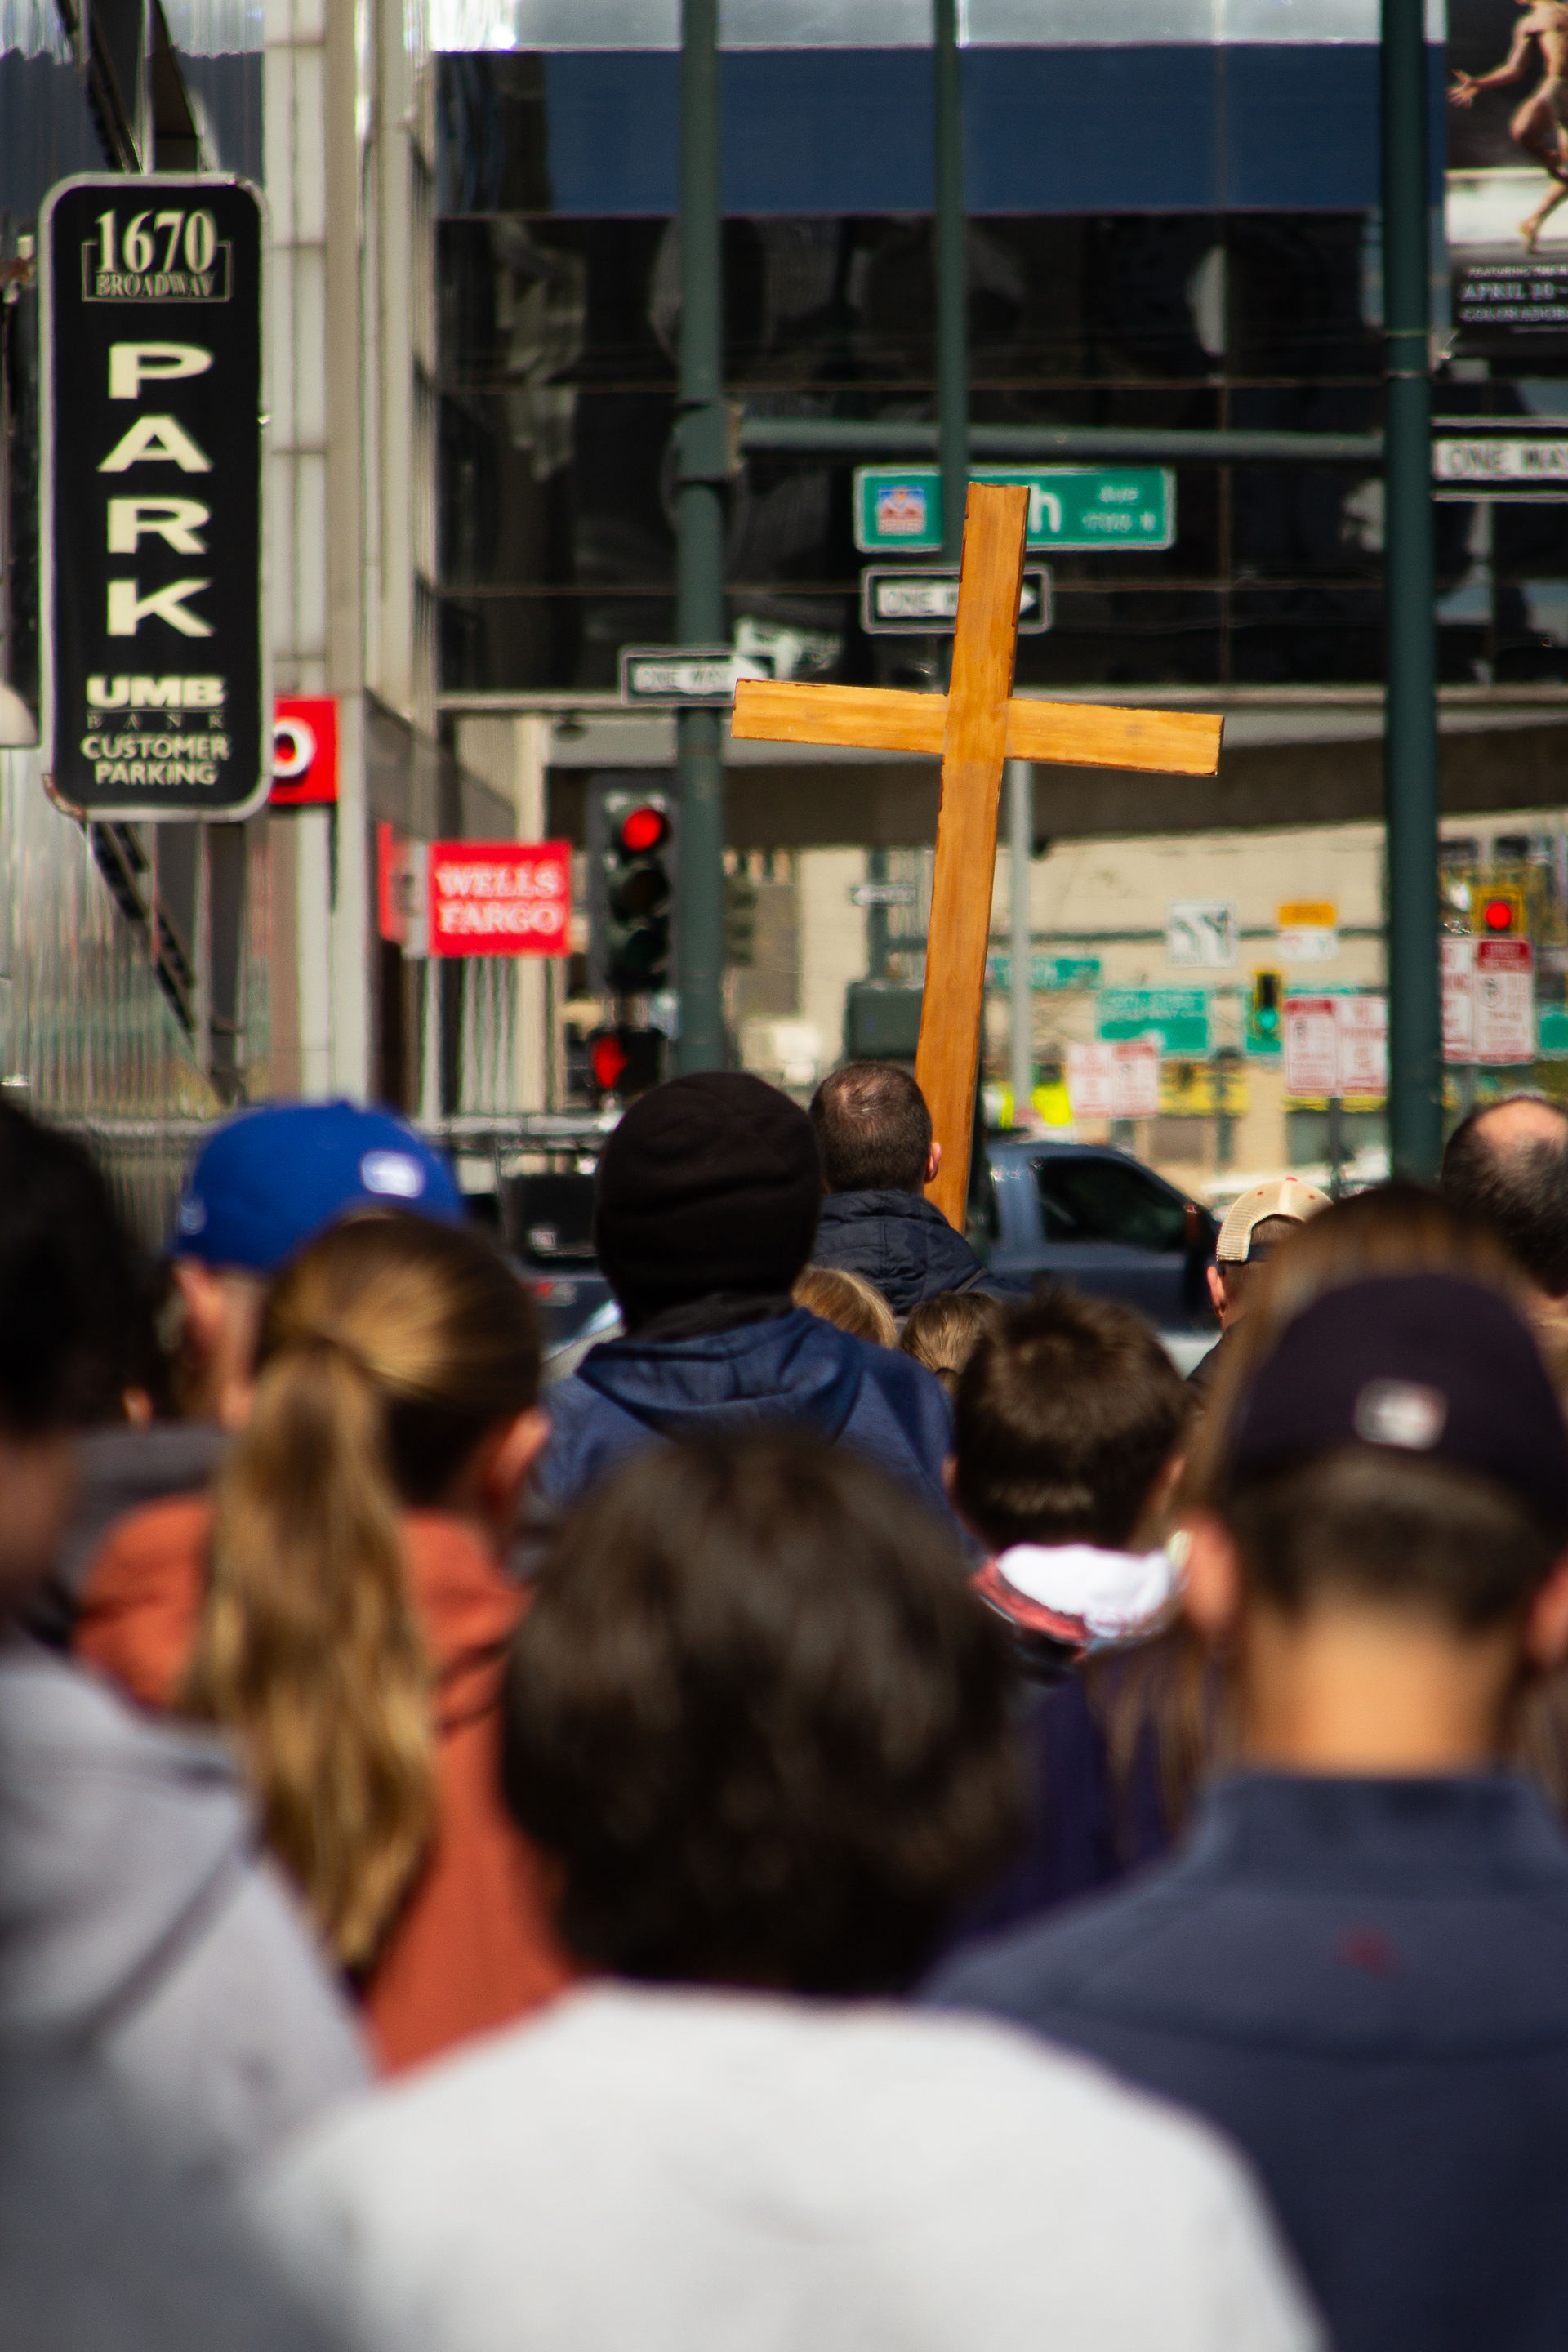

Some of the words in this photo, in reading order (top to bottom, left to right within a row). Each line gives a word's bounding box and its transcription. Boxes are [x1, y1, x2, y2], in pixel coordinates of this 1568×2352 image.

[96, 209, 217, 274] 1670
[96, 273, 215, 297] BROADWAY
[1461, 283, 1526, 301] APRIL
[1449, 445, 1510, 475] ONE
[1521, 445, 1568, 475] WA
[97, 341, 216, 638] PARK
[888, 590, 934, 614] ONE
[87, 676, 226, 708] UMB
[87, 712, 225, 729] BANK
[81, 736, 230, 760] CUSTOMER
[95, 762, 218, 786] PARKING
[435, 866, 559, 898] WELLS
[439, 902, 562, 935] FARGO
